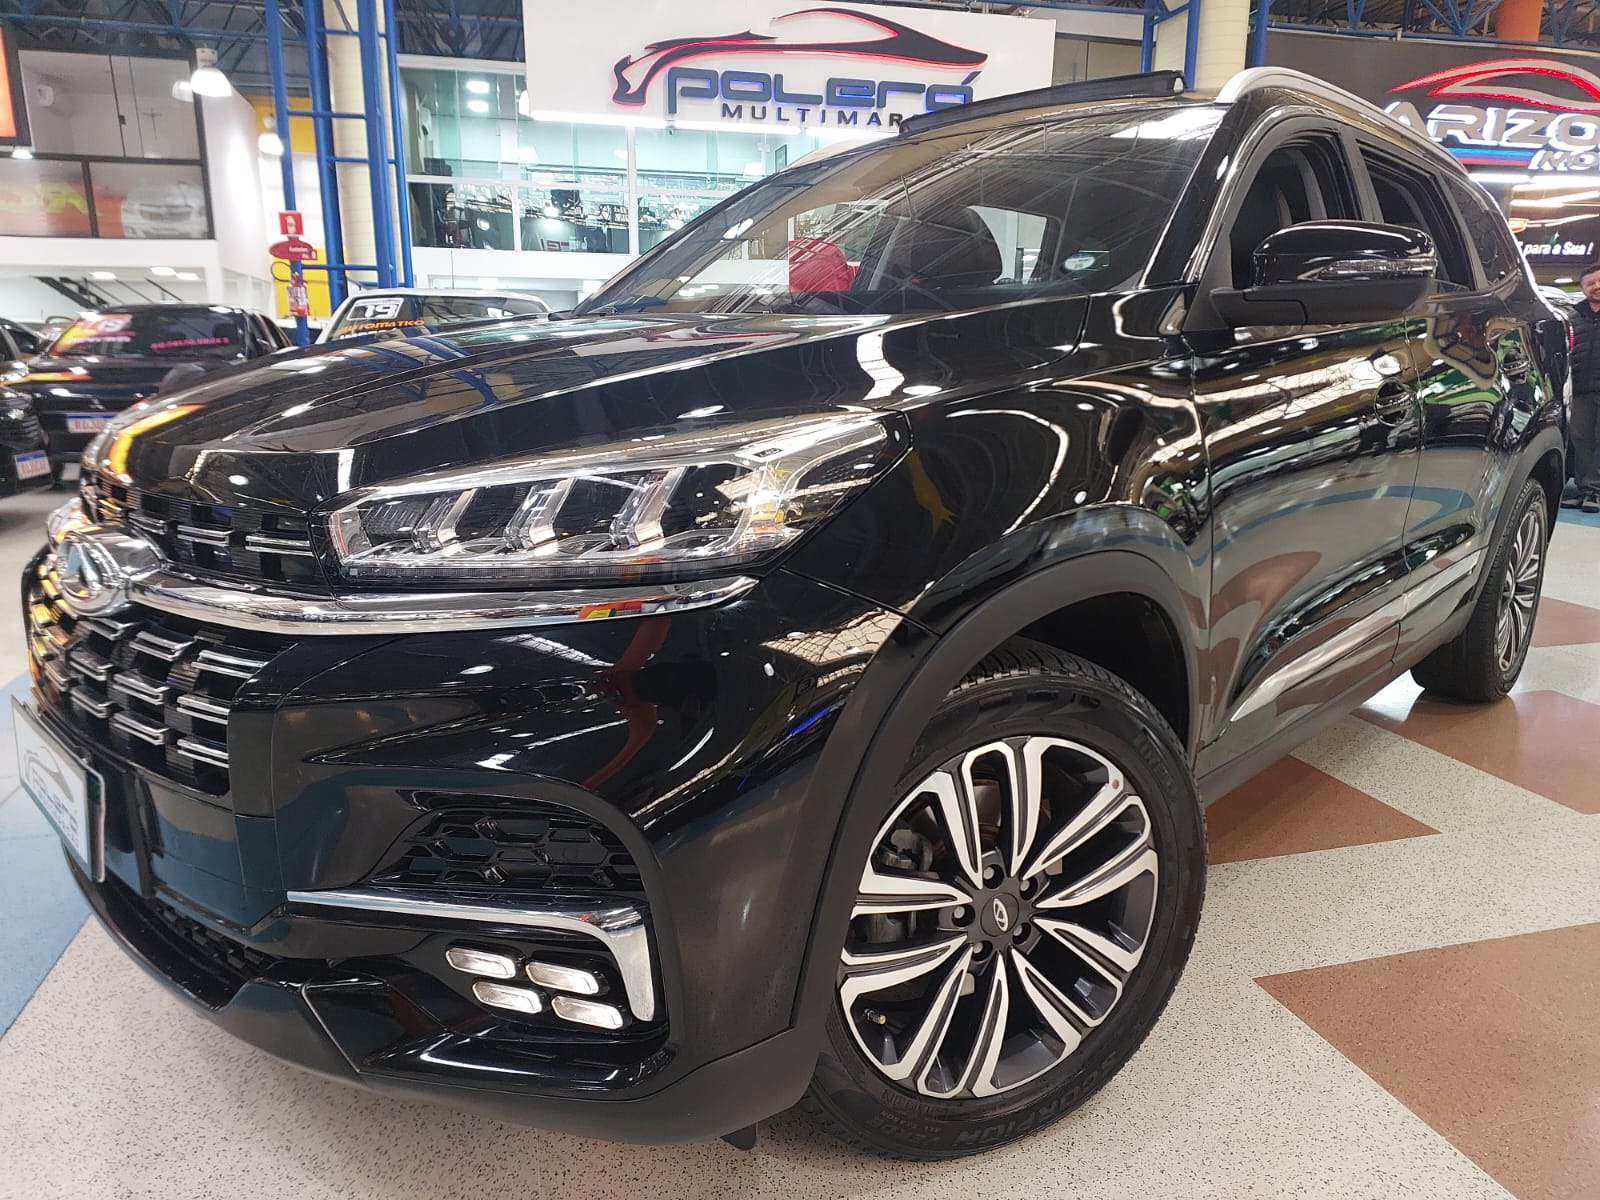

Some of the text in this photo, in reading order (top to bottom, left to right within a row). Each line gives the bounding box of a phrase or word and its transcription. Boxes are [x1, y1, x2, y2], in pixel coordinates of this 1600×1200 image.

[721, 103, 906, 127] MULTIMAR
[1528, 150, 1600, 170] MO
[1523, 243, 1551, 257] para
[1552, 243, 1562, 255] a
